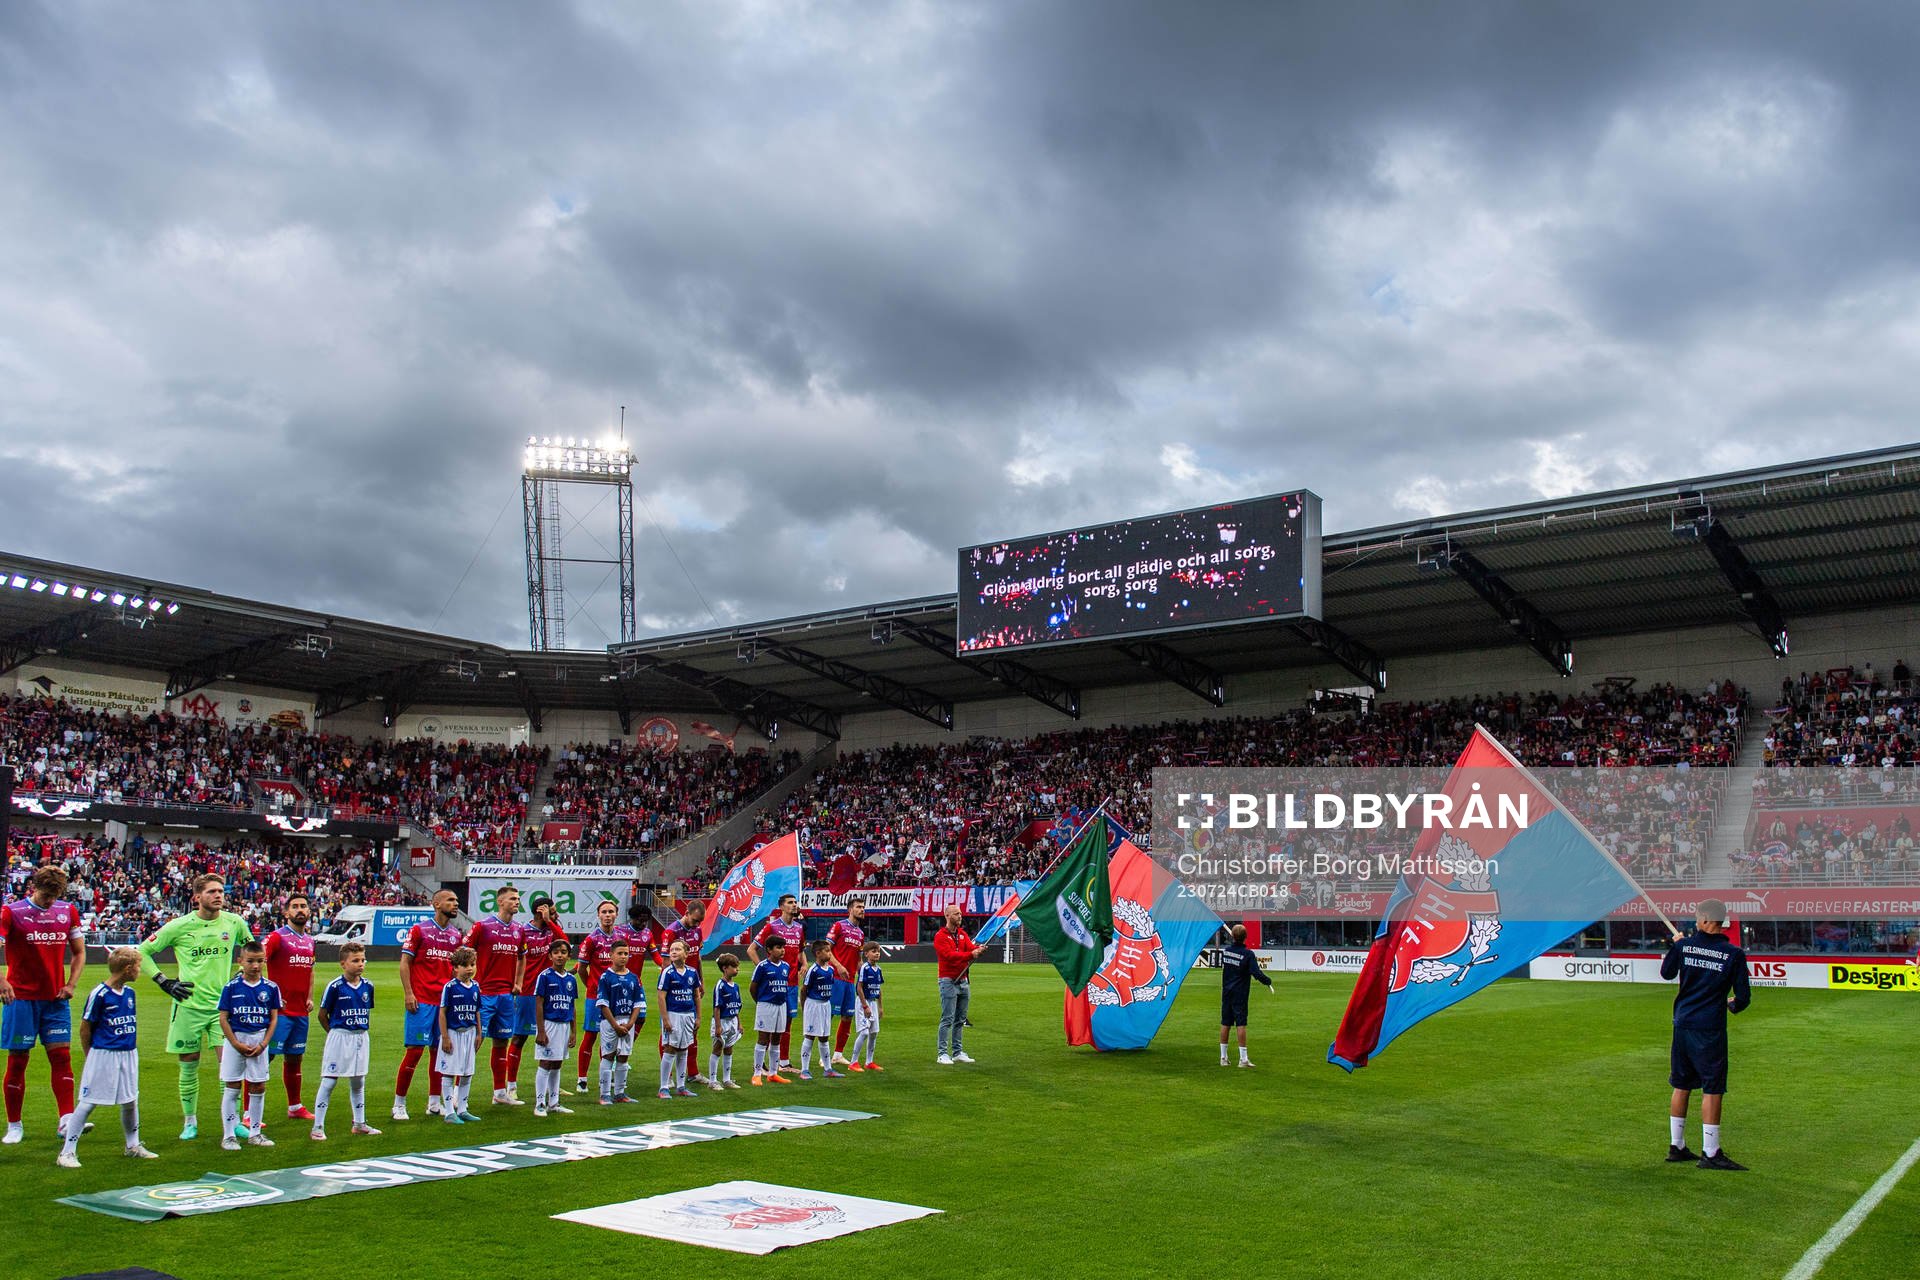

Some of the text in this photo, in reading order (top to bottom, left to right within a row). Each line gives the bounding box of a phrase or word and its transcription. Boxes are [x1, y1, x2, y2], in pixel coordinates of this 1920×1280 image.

[983, 582, 1021, 598] Glöm
[1023, 575, 1065, 593] aldrig
[1104, 565, 1122, 580] all
[1127, 557, 1173, 580] glädje
[1177, 553, 1206, 569] och
[1210, 549, 1230, 563] all
[1124, 577, 1158, 595] sorg
[61, 686, 107, 698] Jönssons
[76, 697, 149, 713] Helsingborg AB
[181, 692, 219, 719] MAX
[470, 867, 521, 875] KLIPPANS
[554, 868, 605, 876] KLIPPANS
[816, 893, 830, 906] DET
[869, 893, 912, 907] TRADITION!
[912, 887, 977, 912] STOPPA
[1786, 901, 1909, 914] FOREVERFASTER
[384, 915, 410, 925] Flytta?
[26, 931, 56, 941] akea
[191, 946, 219, 957] akea
[426, 947, 447, 958] akea
[492, 942, 512, 951] akea
[289, 954, 310, 964] akea
[1326, 954, 1367, 965] AllOffic
[1564, 960, 1629, 977] granitor
[1831, 965, 1906, 989] Design
